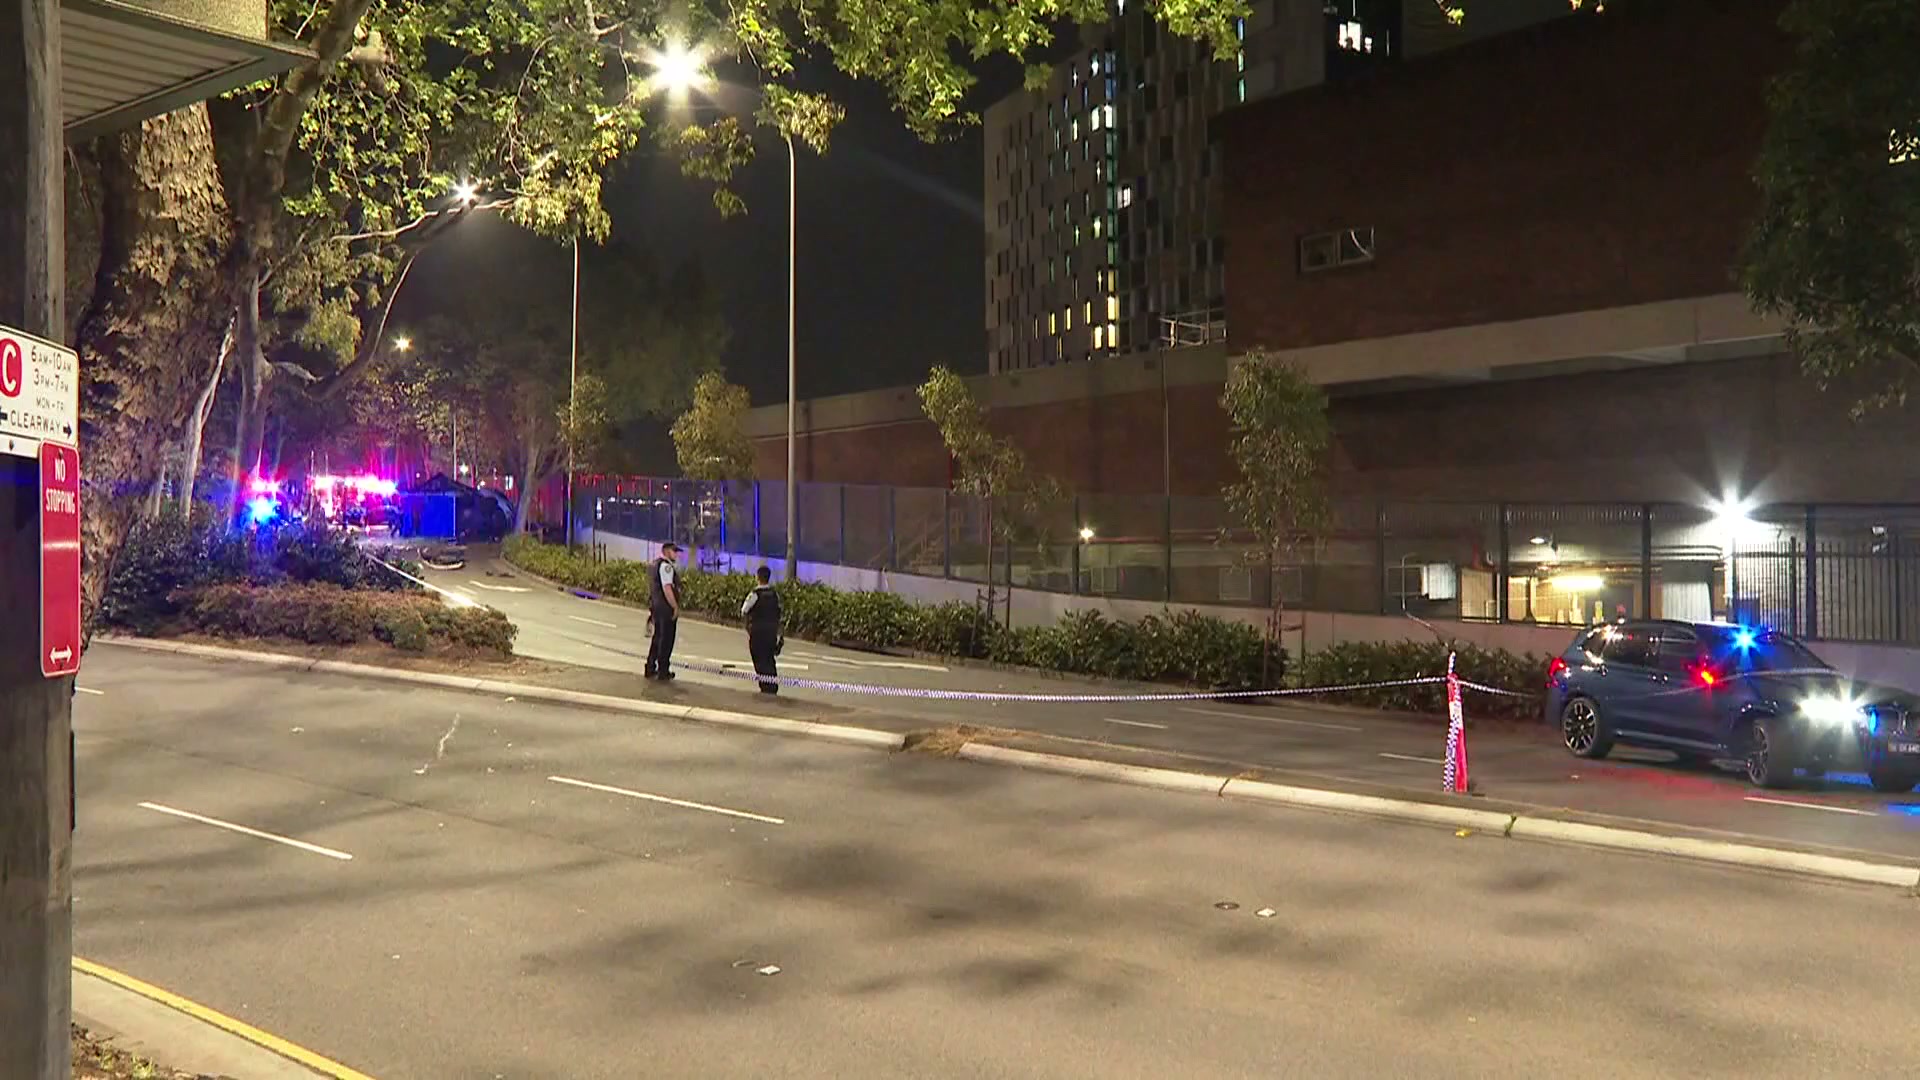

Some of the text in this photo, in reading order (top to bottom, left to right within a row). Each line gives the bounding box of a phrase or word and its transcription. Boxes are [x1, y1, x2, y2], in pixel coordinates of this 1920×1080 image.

[2, 344, 16, 392] C
[10, 410, 61, 433] CLEARWAY
[55, 458, 66, 482] NO
[46, 488, 75, 514] STOPPING
